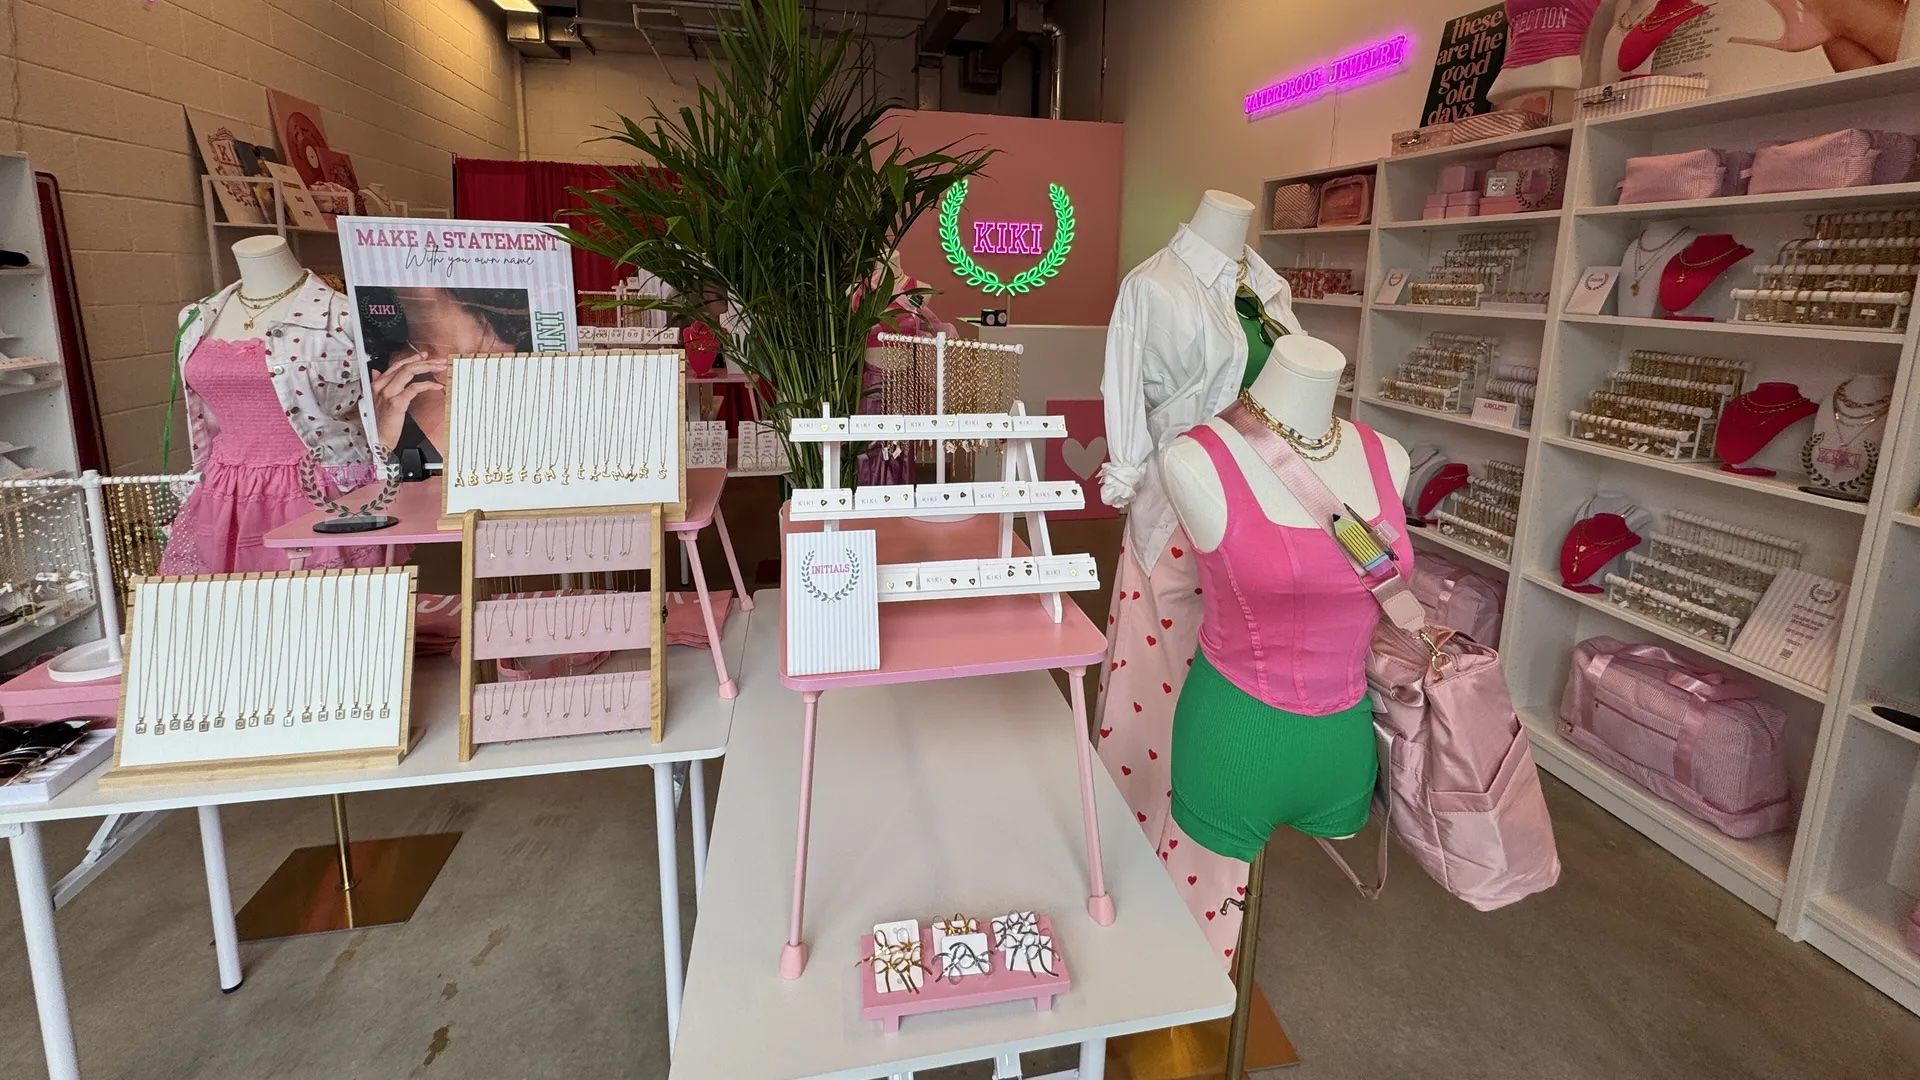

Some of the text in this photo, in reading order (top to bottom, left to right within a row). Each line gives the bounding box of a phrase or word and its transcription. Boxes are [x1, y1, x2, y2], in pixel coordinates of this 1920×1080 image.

[1451, 10, 1503, 44] these
[1328, 39, 1404, 83] JEWELRY
[1436, 32, 1503, 66] are the
[1438, 51, 1492, 95] good
[1445, 76, 1479, 106] old
[1427, 102, 1475, 127] days
[356, 229, 559, 252] MAKE A STATEMENT
[973, 221, 1043, 255] KIKI
[405, 245, 534, 277] With you own name
[368, 304, 396, 315] KIKI
[811, 564, 850, 575] INITIALS
